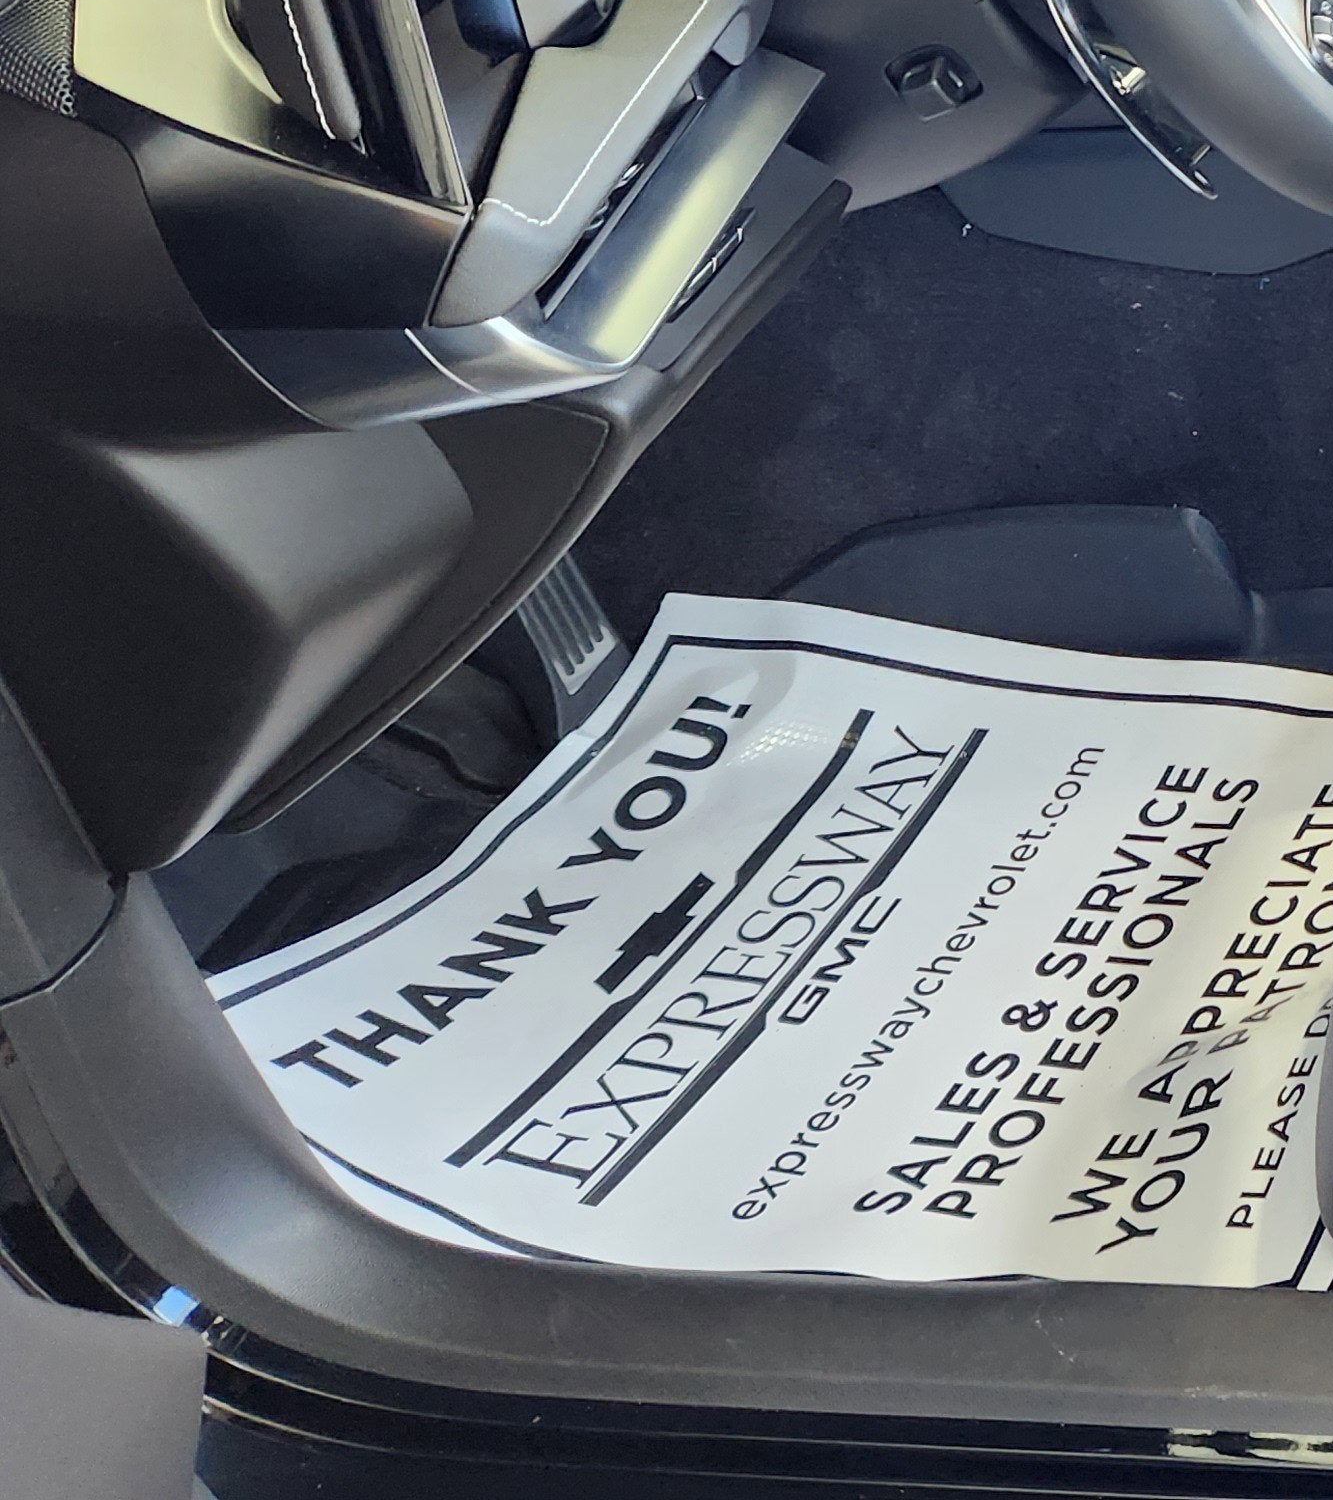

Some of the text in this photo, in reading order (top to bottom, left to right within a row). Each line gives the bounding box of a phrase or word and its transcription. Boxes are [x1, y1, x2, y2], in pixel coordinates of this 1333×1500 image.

[270, 695, 752, 1089] THANK YOU!
[482, 725, 955, 1190] EXPRESSWAY
[732, 747, 1105, 1221] expresswaychevrolet.com
[778, 896, 902, 1025] GMC
[853, 765, 1209, 1215] SALES & SERVICE
[923, 778, 1259, 1220] PROFESSIONALS
[1050, 1128, 1158, 1222] WE
[1096, 1069, 1234, 1254] YOUR
[1225, 1054, 1318, 1229] PLEASE
